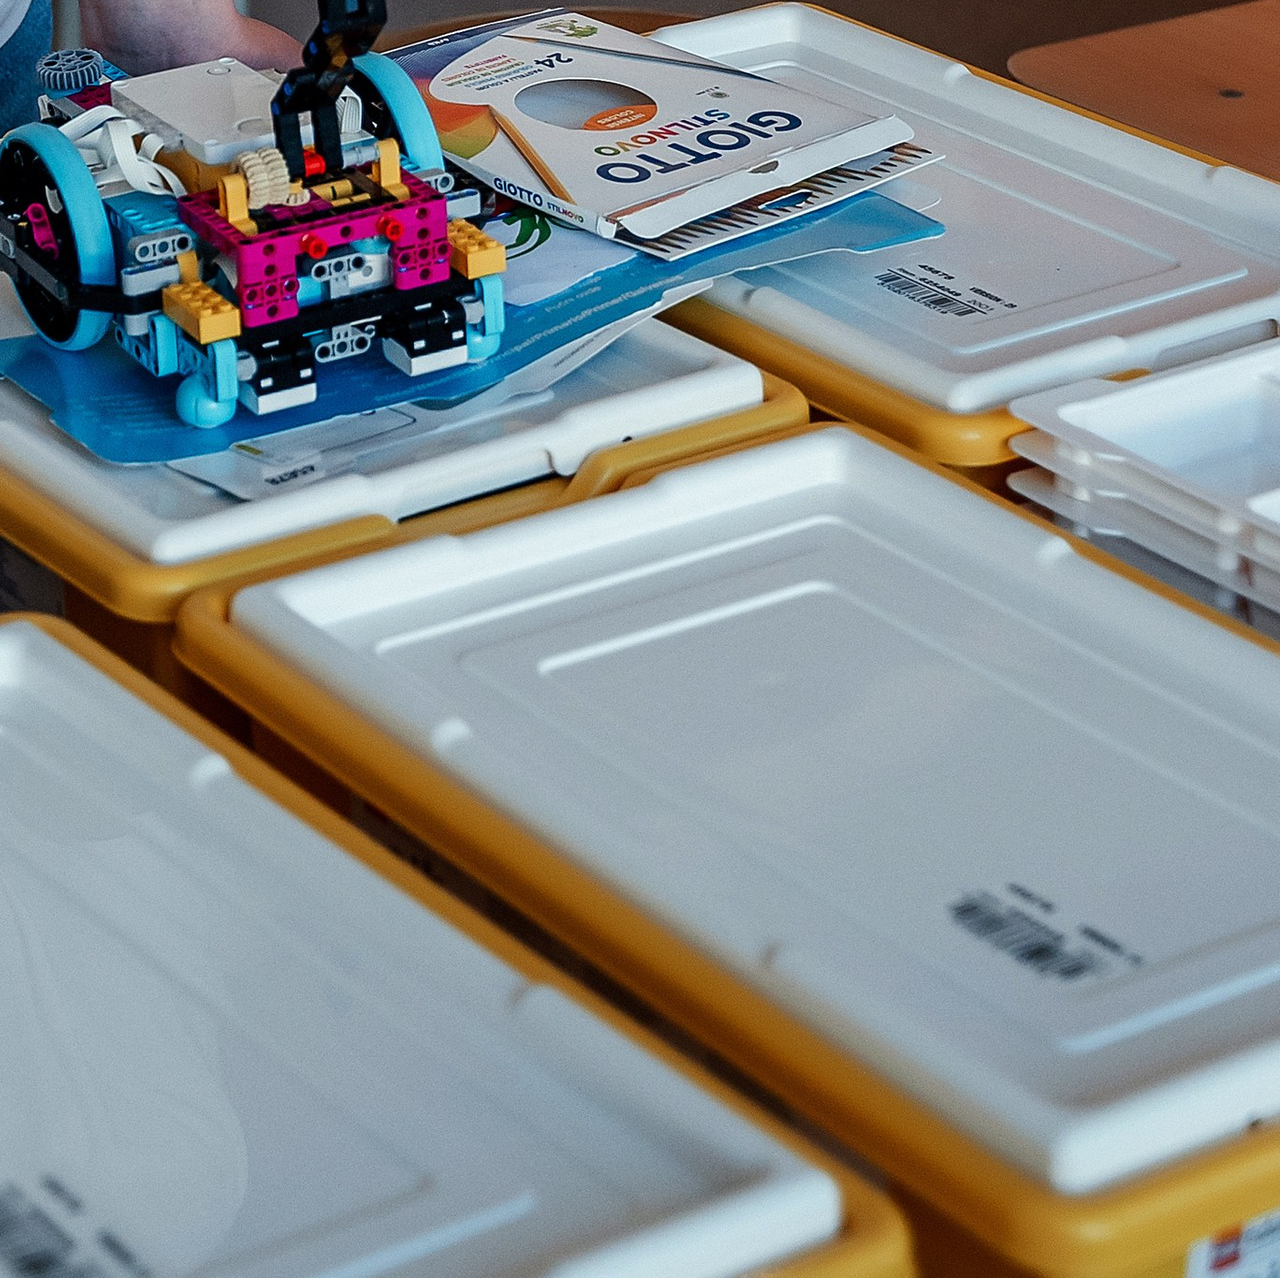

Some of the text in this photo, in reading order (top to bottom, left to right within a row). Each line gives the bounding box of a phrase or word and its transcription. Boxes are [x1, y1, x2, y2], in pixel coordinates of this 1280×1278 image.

[534, 52, 573, 69] 24
[594, 109, 731, 157] STILNOVO
[596, 110, 803, 184] GIOTTO
[493, 177, 585, 224] GIOTTO STILNOVO
